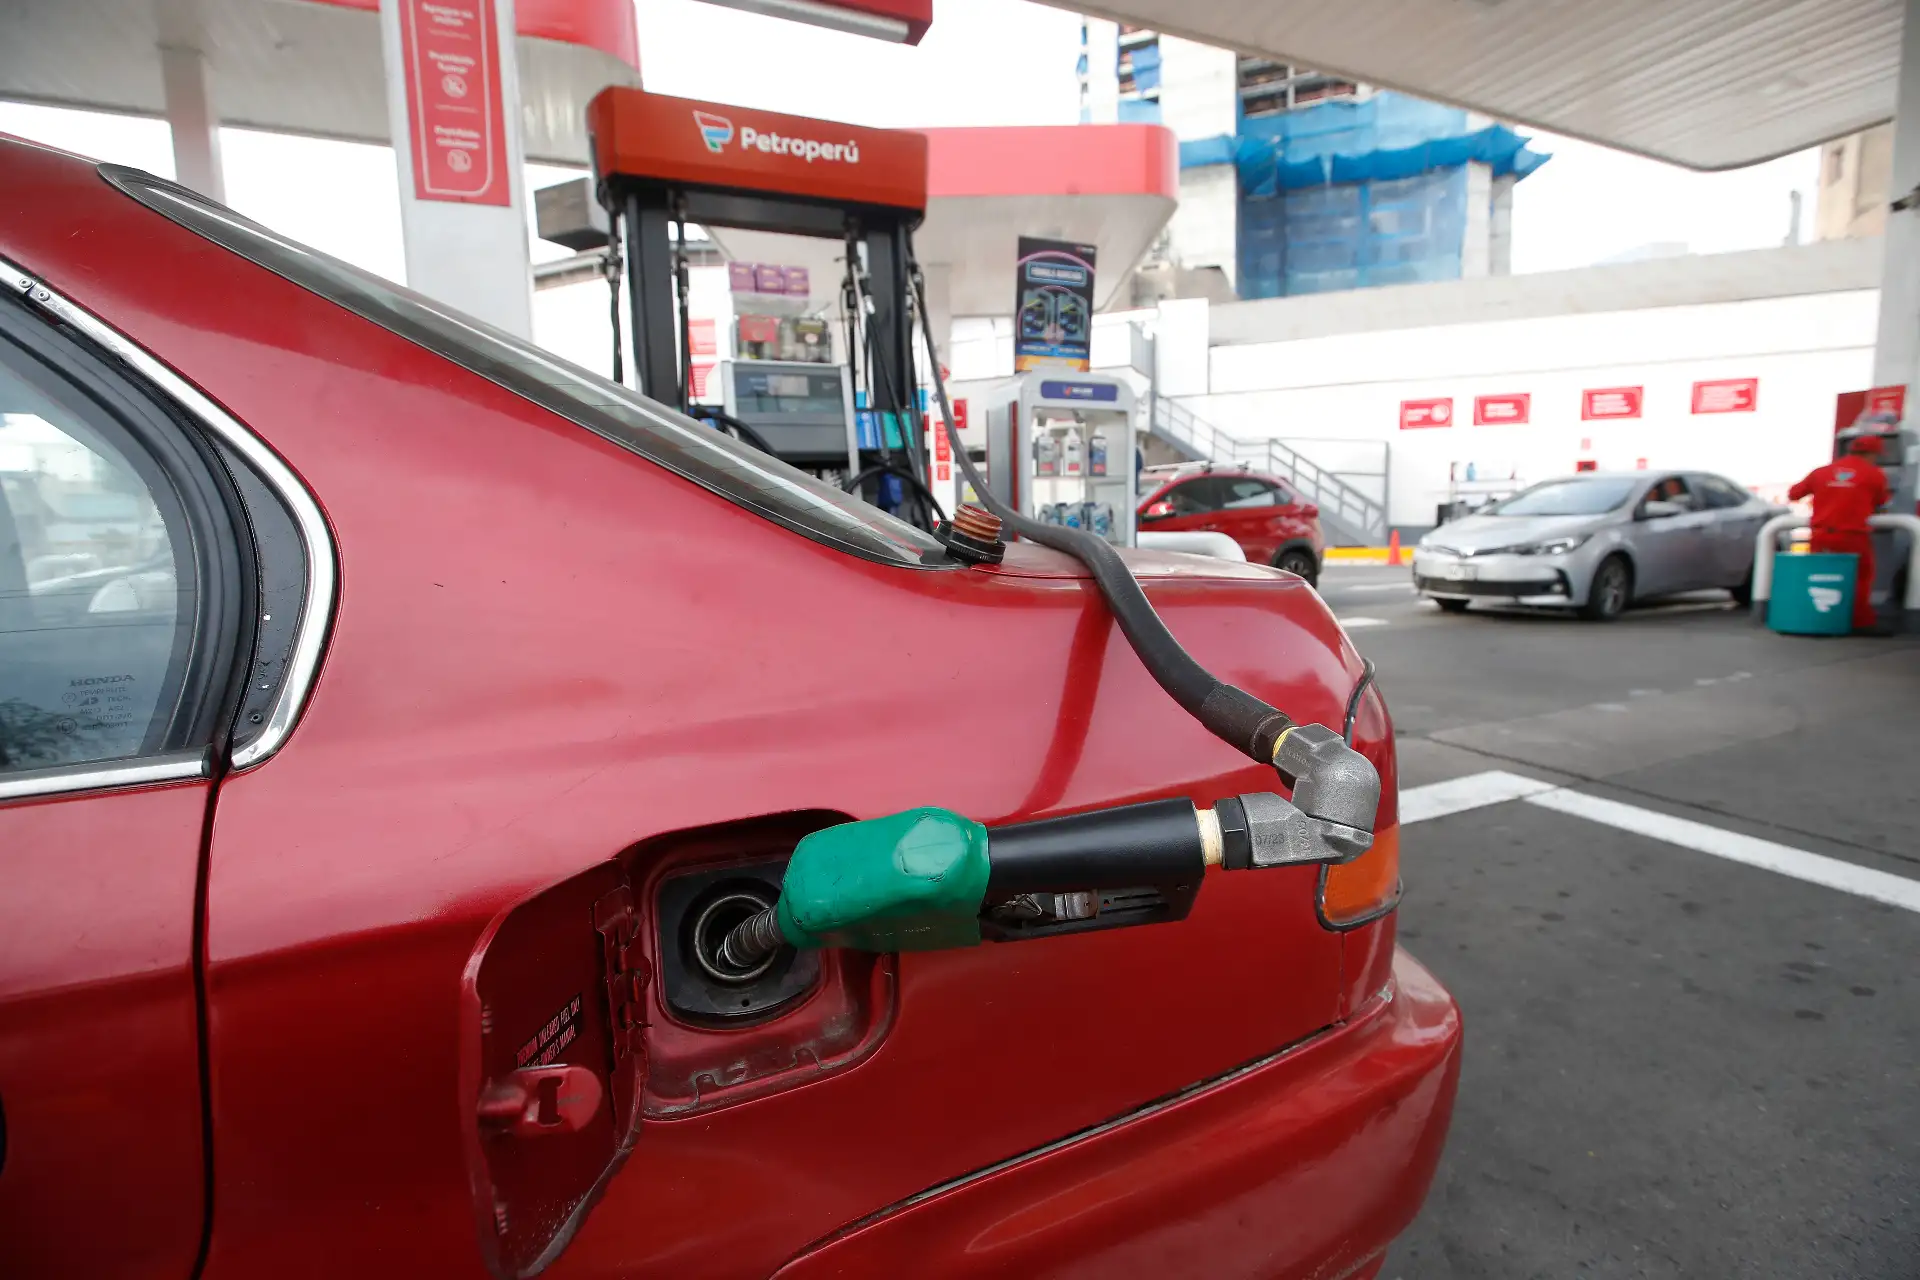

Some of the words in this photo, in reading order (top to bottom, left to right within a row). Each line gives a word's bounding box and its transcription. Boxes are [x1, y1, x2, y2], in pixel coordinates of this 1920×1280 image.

[740, 126, 860, 164] Petroperú
[70, 674, 135, 687] HONDA
[560, 1006, 571, 1026] FUEL
